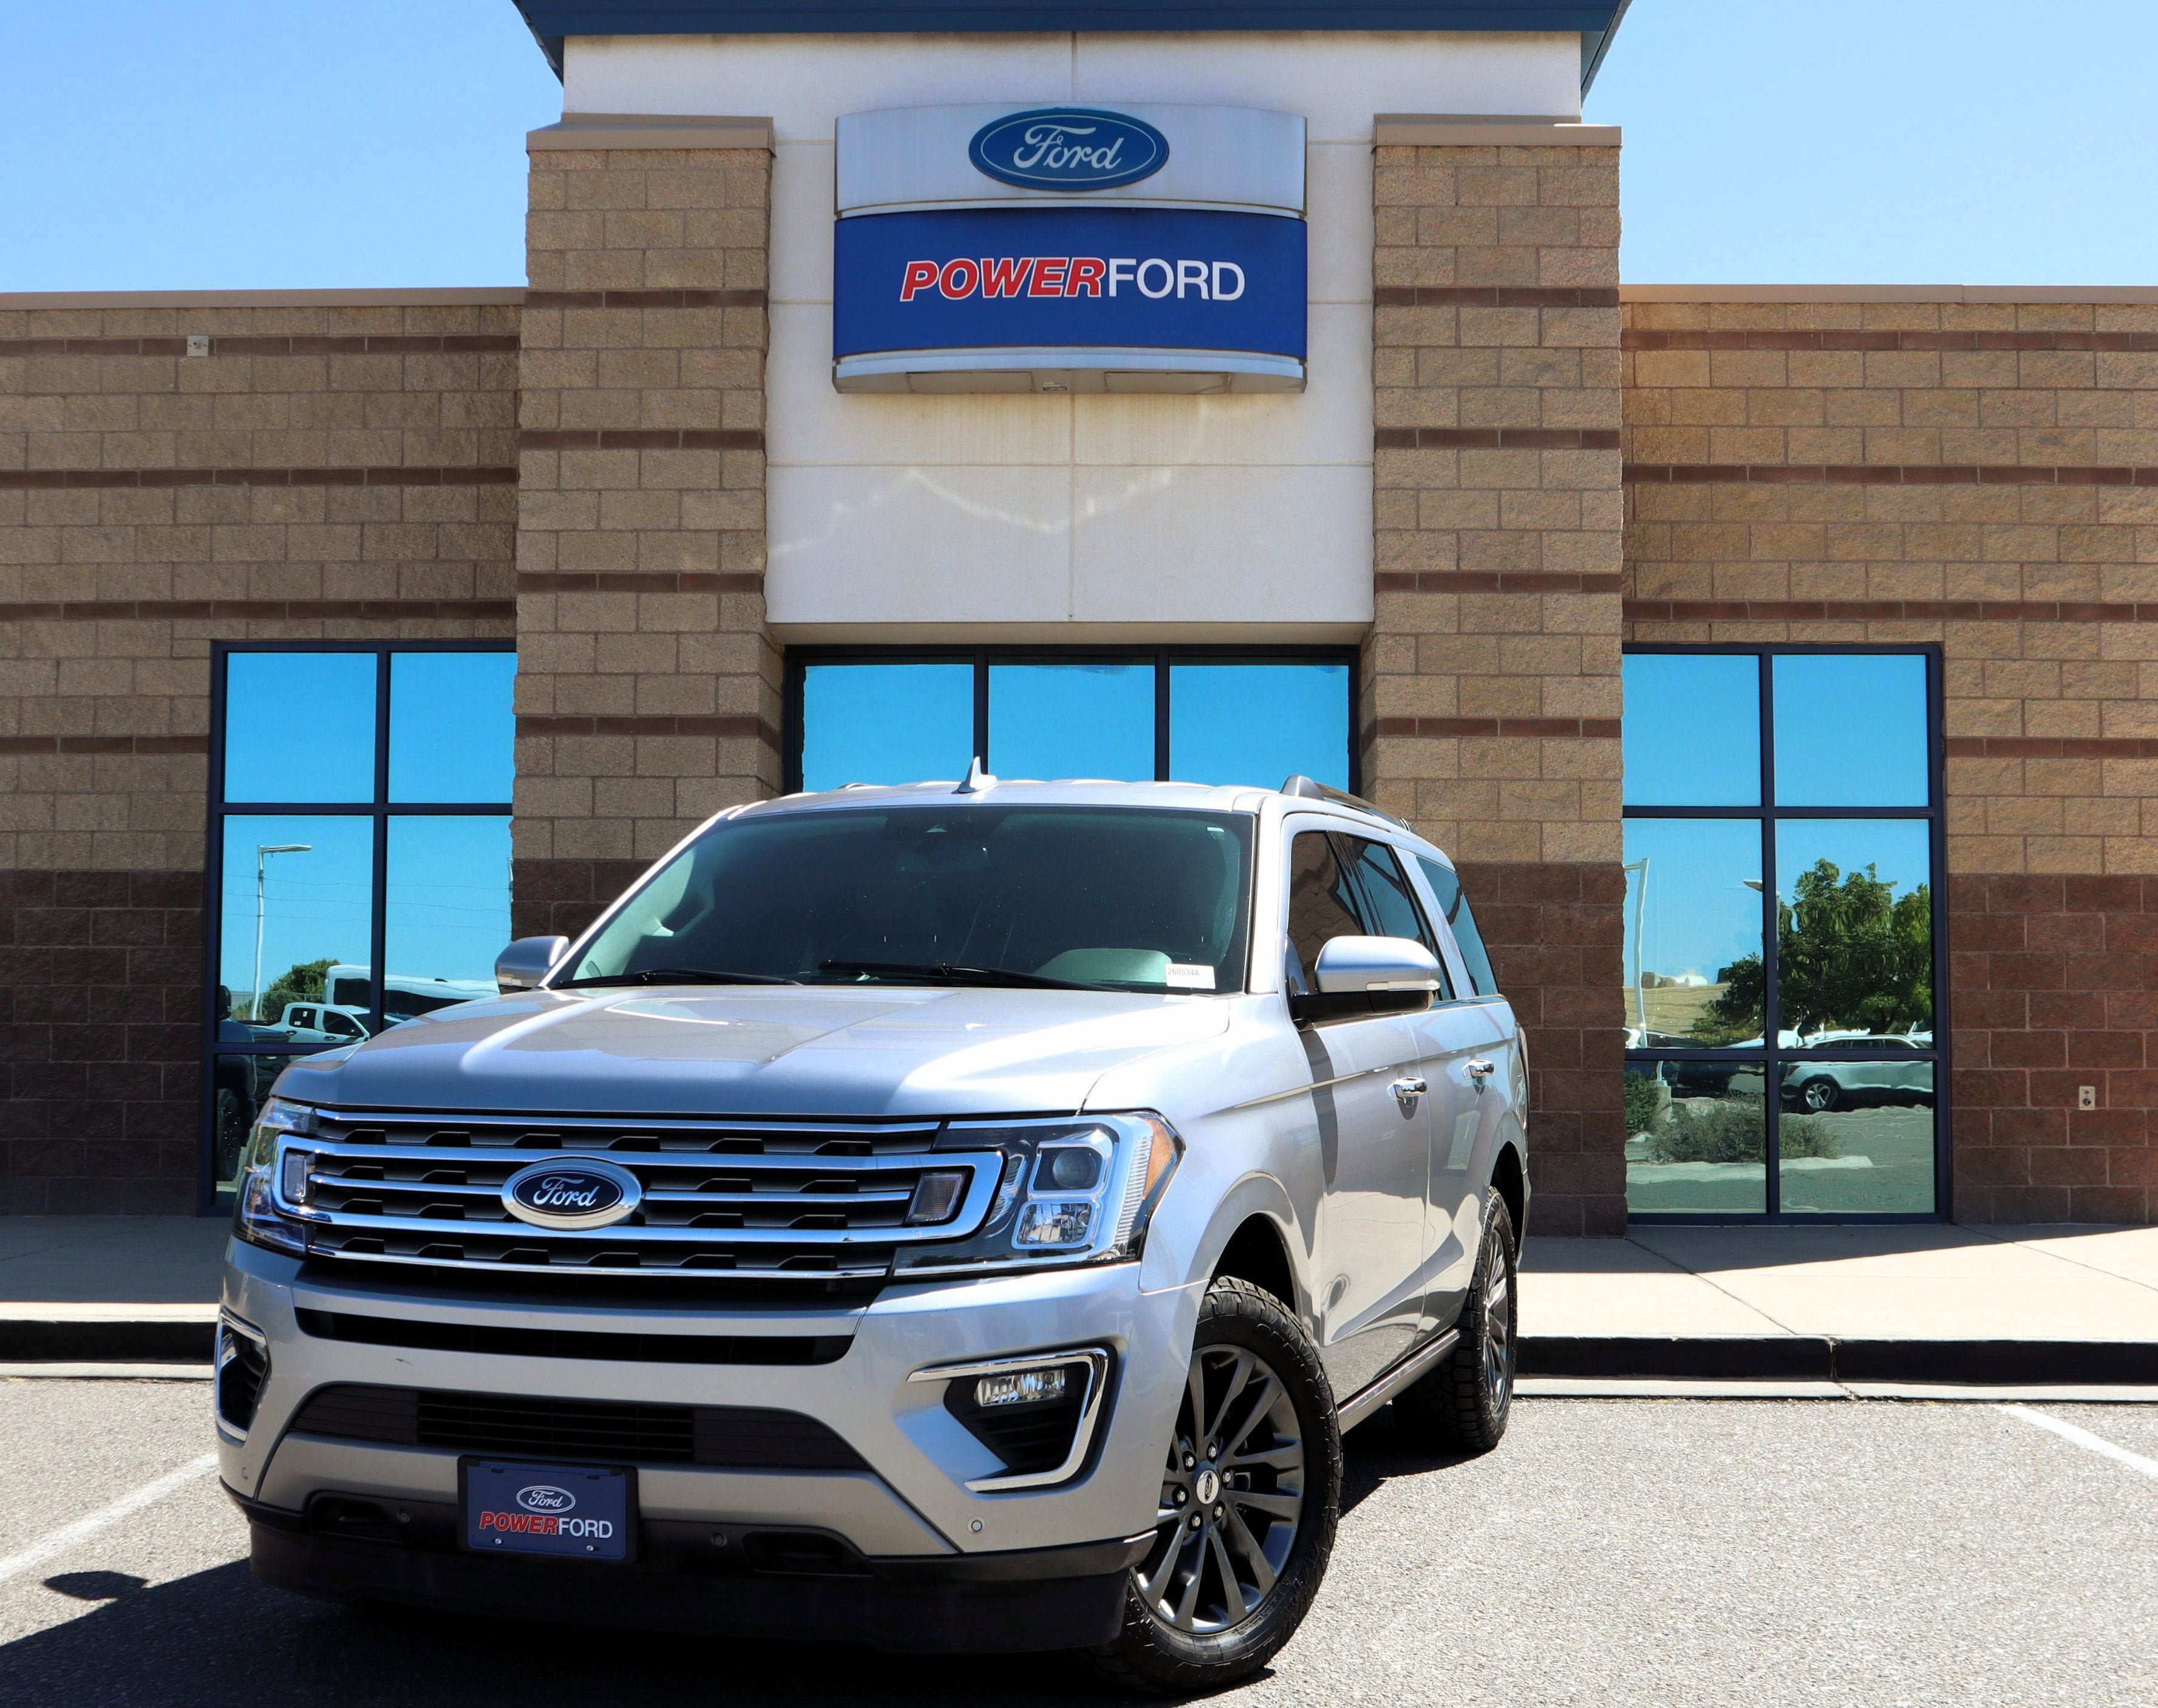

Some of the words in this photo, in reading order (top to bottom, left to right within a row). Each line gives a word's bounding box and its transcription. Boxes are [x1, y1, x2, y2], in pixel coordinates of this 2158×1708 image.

[1013, 124, 1125, 171] Ford
[533, 1177, 601, 1206] Ford
[528, 1490, 563, 1508] Ford
